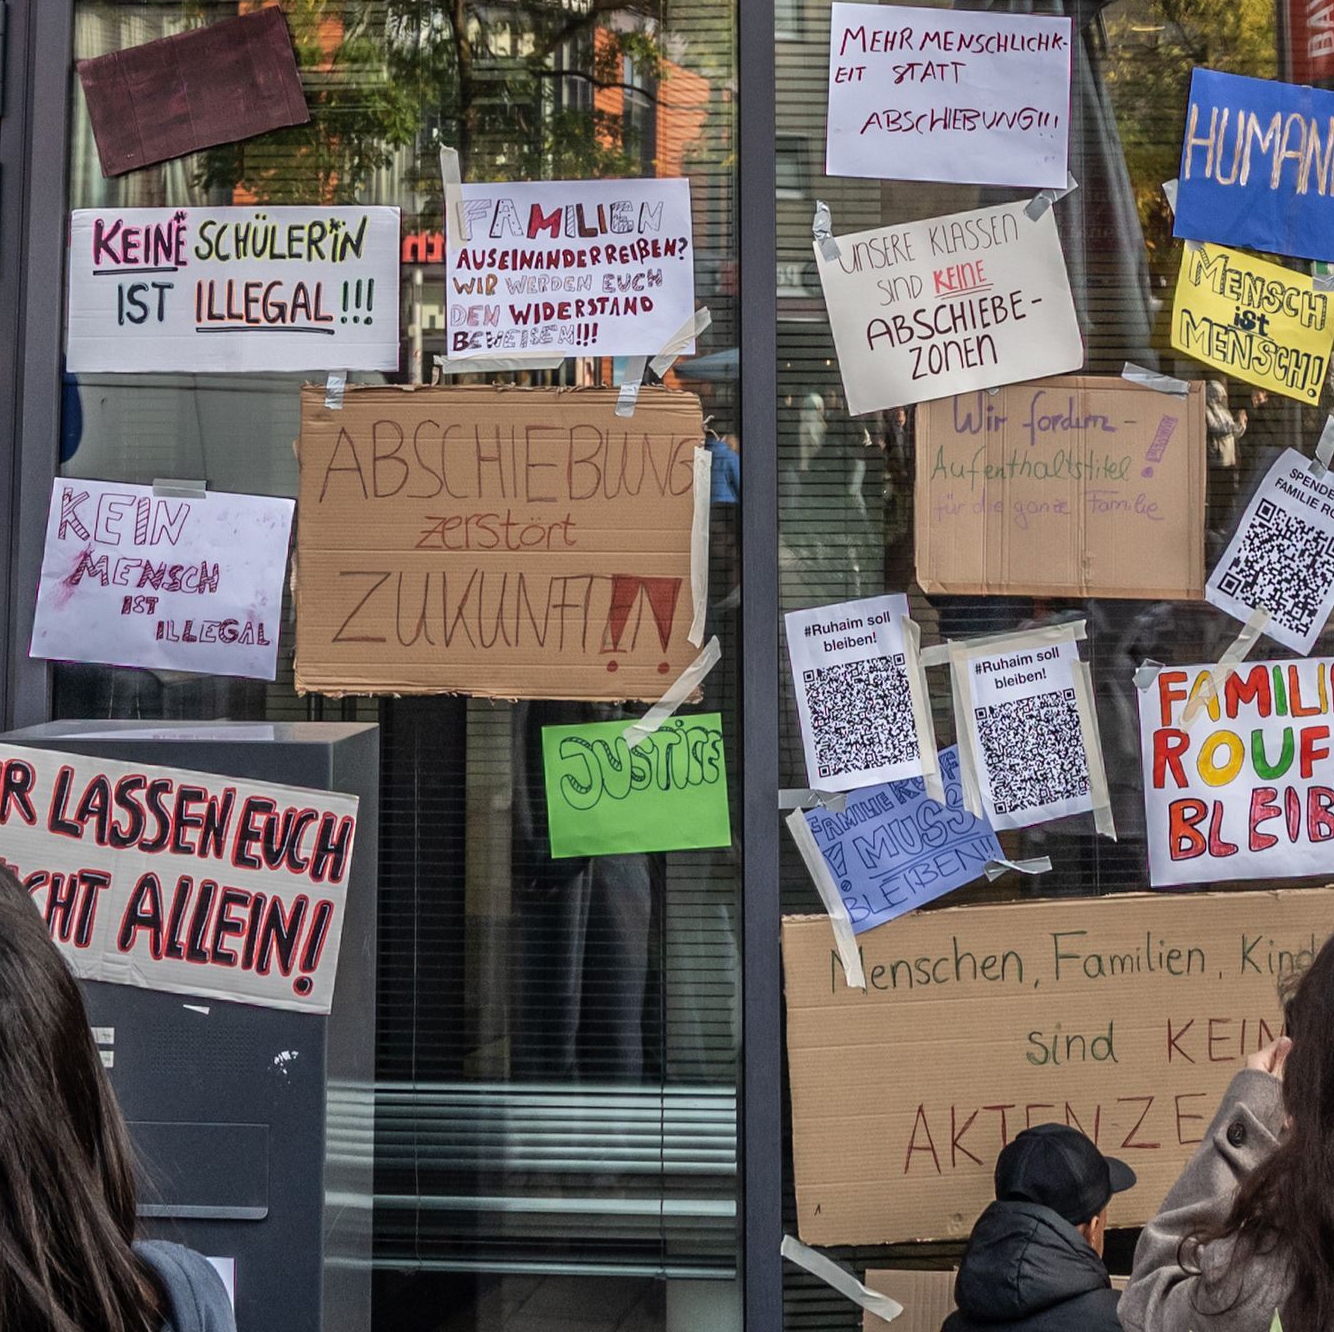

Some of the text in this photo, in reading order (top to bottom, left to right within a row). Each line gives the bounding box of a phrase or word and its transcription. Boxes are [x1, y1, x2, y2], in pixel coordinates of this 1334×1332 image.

[839, 24, 914, 56] MEHR
[834, 61, 967, 85] EIT STATT
[456, 197, 665, 242] FAMILIEN
[452, 268, 664, 297] WIR WERDEN EUCH
[932, 259, 988, 294] KEINE
[1187, 245, 1329, 332] MENSCH
[117, 278, 375, 328] IST ILLEGAL!!!
[450, 295, 655, 328] DEN WIDERSTAND
[866, 293, 1043, 352] ABSCHIEBE-
[1232, 305, 1271, 338] ist
[1180, 309, 1325, 399] MENSCH!
[953, 392, 1008, 435] Wir
[318, 420, 698, 504] ABSCHIEBUNG
[933, 493, 967, 522] für
[1083, 489, 1165, 521] Familie
[1274, 477, 1320, 510] FAMILIE
[55, 485, 193, 548] KEIN
[414, 508, 579, 552] zerstört
[69, 554, 221, 594] MENSCH
[121, 594, 160, 617] IST
[803, 611, 892, 639] #Ruhaim soll
[155, 617, 272, 647] ILLEGAL
[822, 630, 879, 654] bleiben!
[973, 646, 1061, 676] #Ruhaim soll
[993, 667, 1048, 691] bleiben!
[558, 718, 723, 811] JUSTICE
[1152, 725, 1331, 790] ROUF
[47, 764, 237, 860] LASSEN
[230, 794, 355, 884] EUCH
[806, 790, 896, 850] FAMILIE
[852, 782, 986, 871] MUSS
[116, 871, 335, 997] ALLEIN!
[1025, 1019, 1119, 1068] sind
